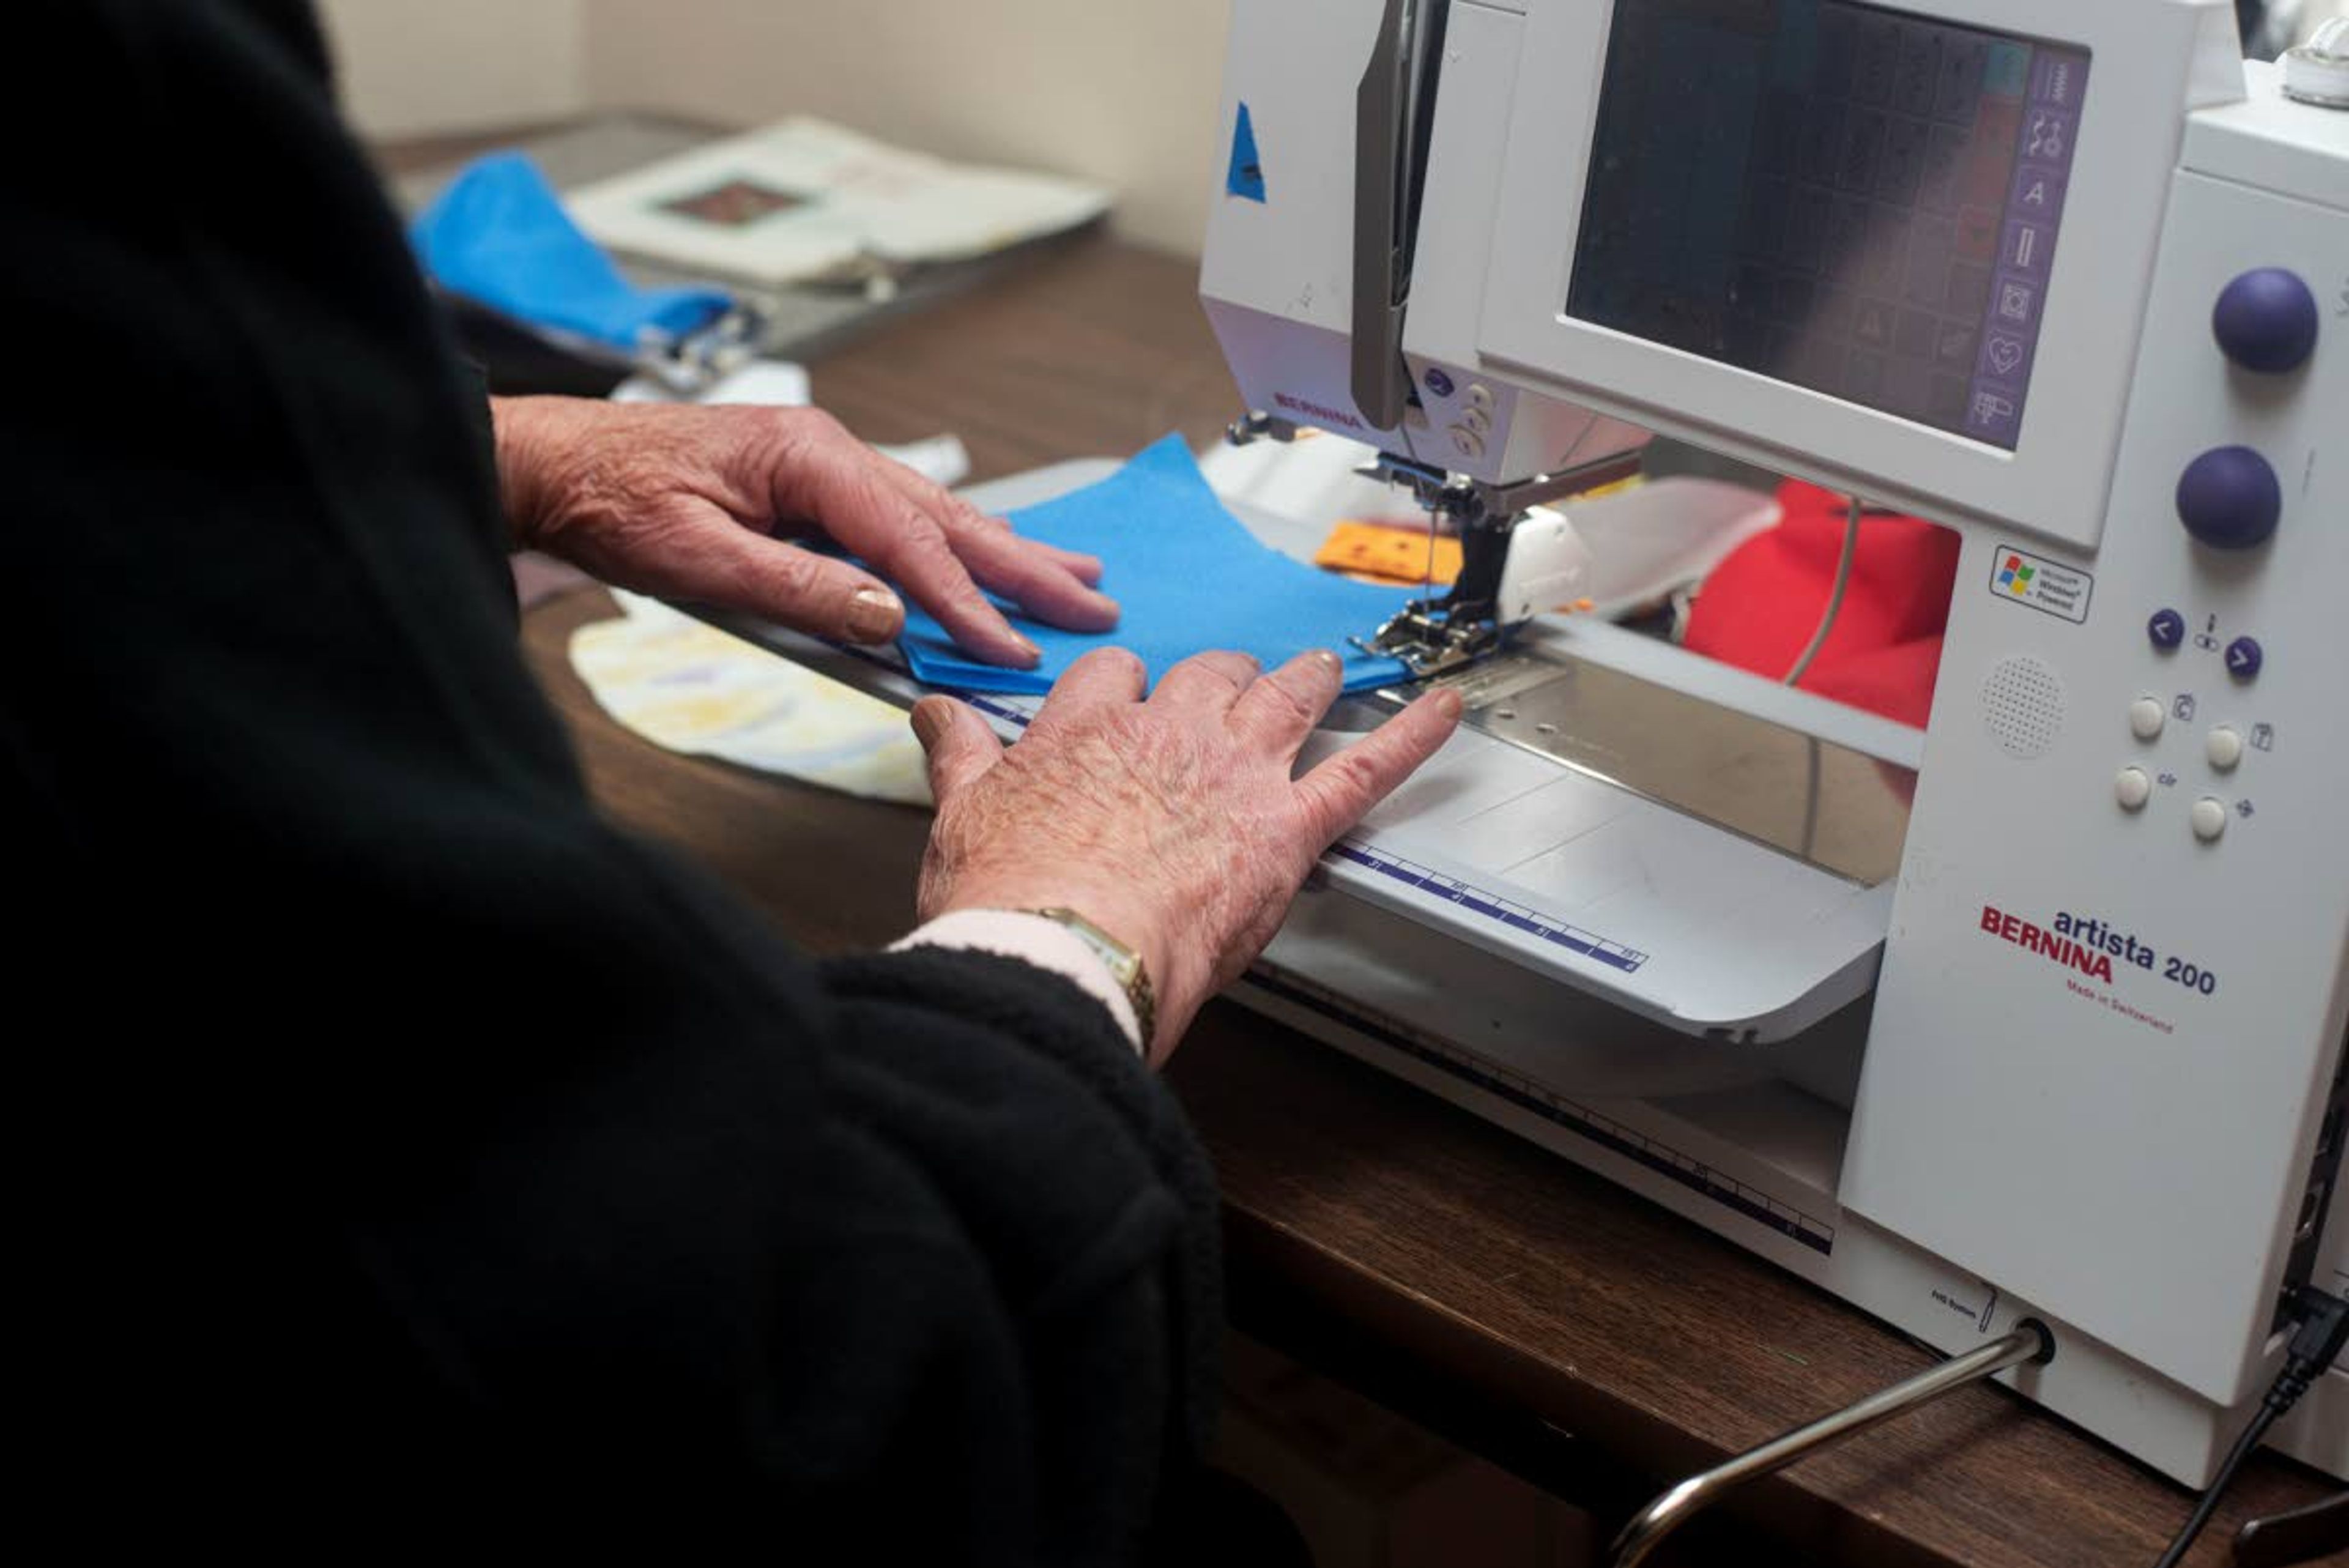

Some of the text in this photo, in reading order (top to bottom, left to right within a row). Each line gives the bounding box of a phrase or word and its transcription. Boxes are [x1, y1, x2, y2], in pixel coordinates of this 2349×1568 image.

[1981, 906, 2112, 984] BERNINA
[2054, 912, 2215, 995] artista 200
[2067, 979, 2173, 1034] Made in Switzerland
